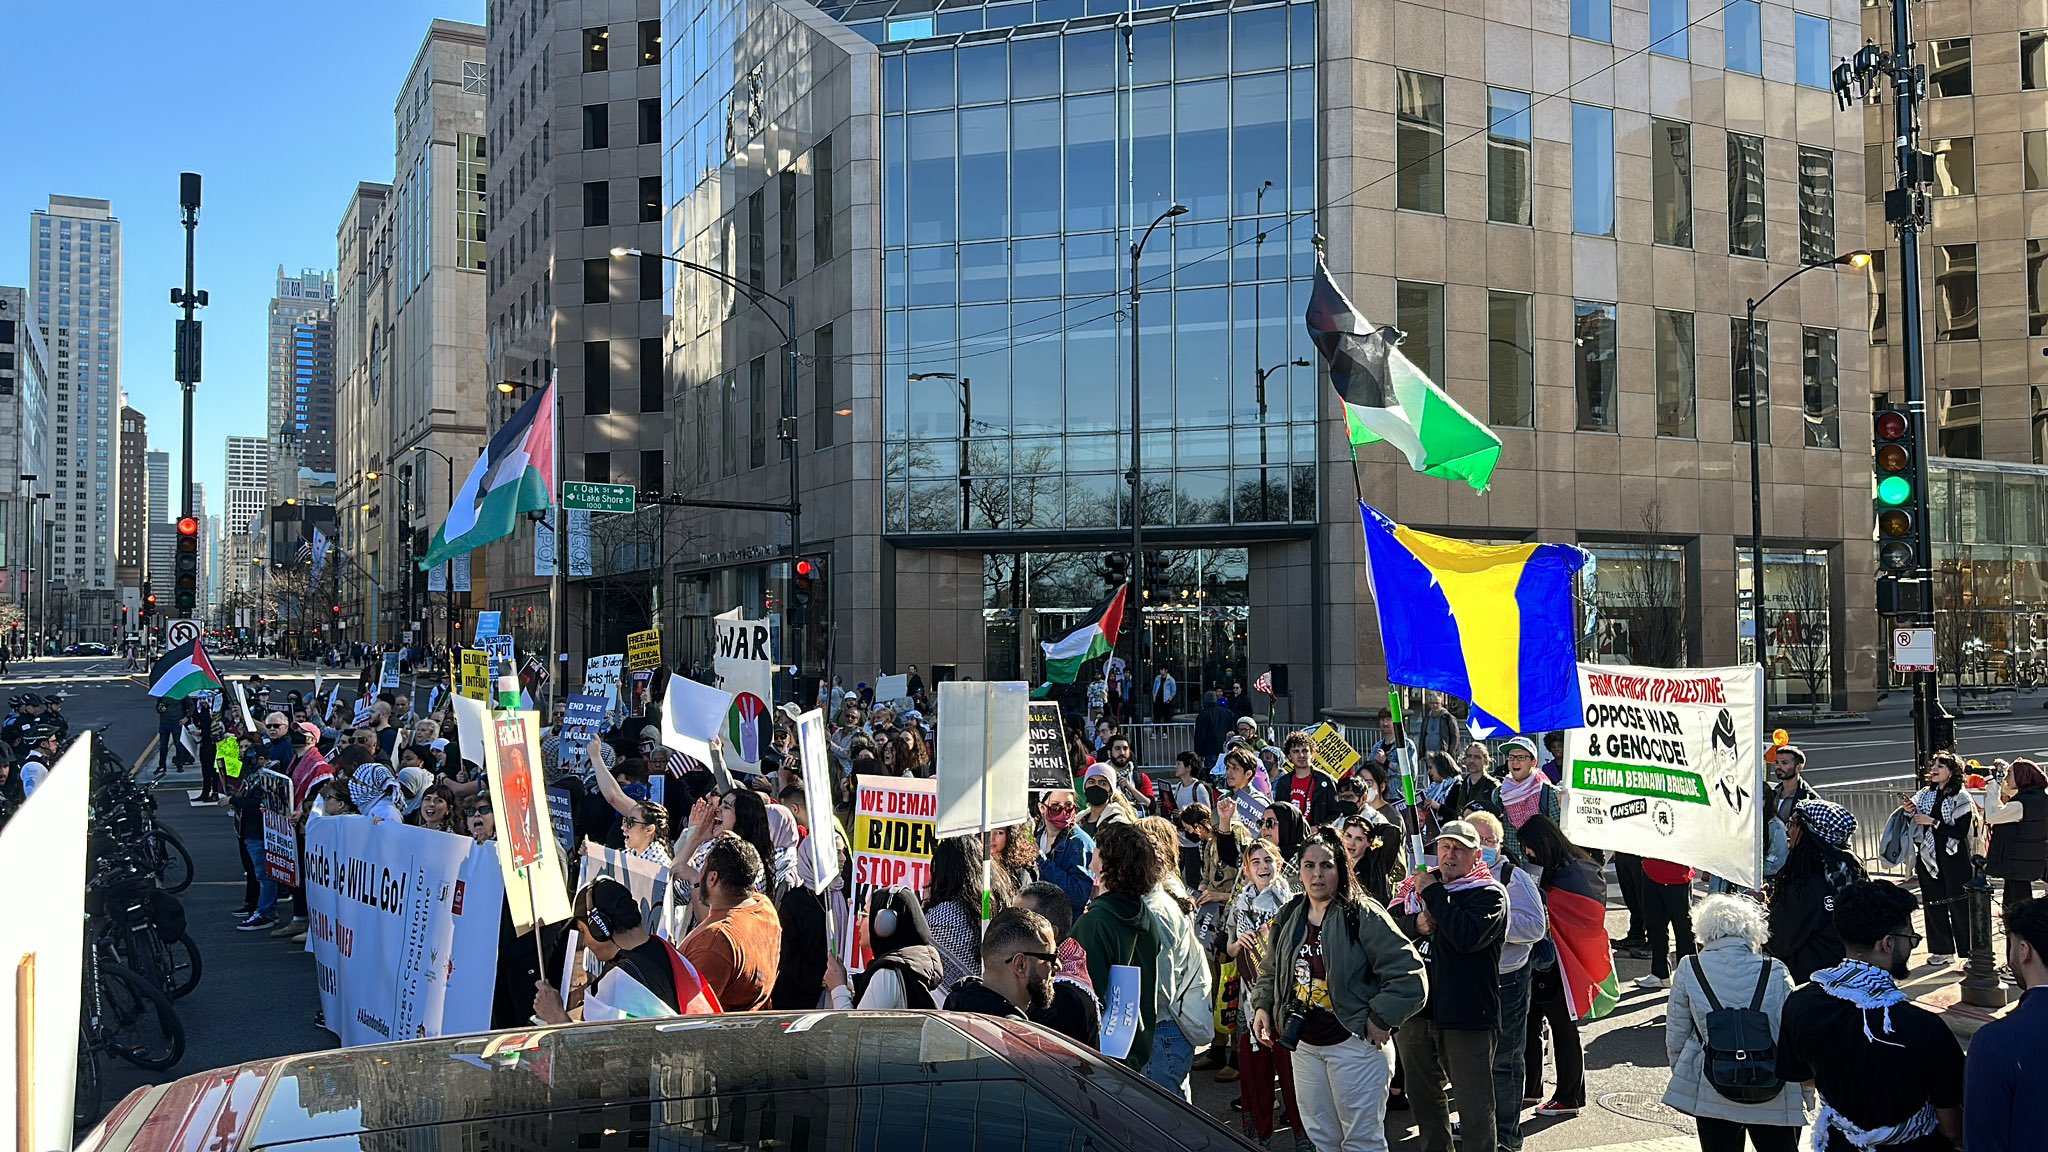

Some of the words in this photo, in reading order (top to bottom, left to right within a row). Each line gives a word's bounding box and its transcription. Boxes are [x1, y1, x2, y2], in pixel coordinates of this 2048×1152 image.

[581, 484, 600, 494] Oak
[582, 494, 600, 502] Lake
[602, 494, 623, 504] Shore
[628, 636, 644, 645] FREE
[646, 632, 658, 641] ALL
[718, 625, 769, 660] WAR
[630, 650, 659, 662] POLITICAL
[631, 657, 660, 668] PRISONERS
[1588, 674, 1616, 698] FROM
[1614, 675, 1650, 701] AFRICA
[1650, 678, 1666, 703] TO
[586, 704, 602, 712] THE
[563, 717, 601, 727] GENOCIDE
[1586, 704, 1646, 730] OPPOSE
[1643, 708, 1683, 735] WAR
[1029, 729, 1056, 740] NDS
[1029, 744, 1049, 755] OFF
[1320, 739, 1346, 763] AARON
[1326, 731, 1352, 757] HONOR
[1588, 733, 1600, 757] &
[1606, 734, 1688, 766] GENOCIDE!
[1029, 757, 1064, 769] EMEN!
[1314, 740, 1346, 775] SHNELL!
[1584, 768, 1624, 788] FATIMA
[1625, 771, 1666, 792] BERNAWI
[1666, 775, 1700, 797] BRIGADE
[557, 797, 568, 805] THE
[861, 790, 884, 813] WE
[888, 791, 936, 817] DEMAN
[1583, 796, 1601, 805] CHICAGO
[550, 809, 572, 820] ENOCIDE
[1249, 805, 1263, 820] THE
[1577, 806, 1601, 815] LIBERATION
[1612, 801, 1645, 818] ANSWER
[1587, 816, 1603, 824] CENTER
[868, 818, 936, 854] BIDEN
[306, 844, 330, 888] ocide
[347, 857, 377, 907] WILL
[381, 867, 406, 916] Go!
[856, 856, 906, 888] STOP
[403, 899, 421, 981] Coalition
[416, 866, 424, 893] for
[1199, 912, 1214, 940] NOW!
[409, 979, 417, 996] in
[1105, 986, 1120, 1036] STAND
